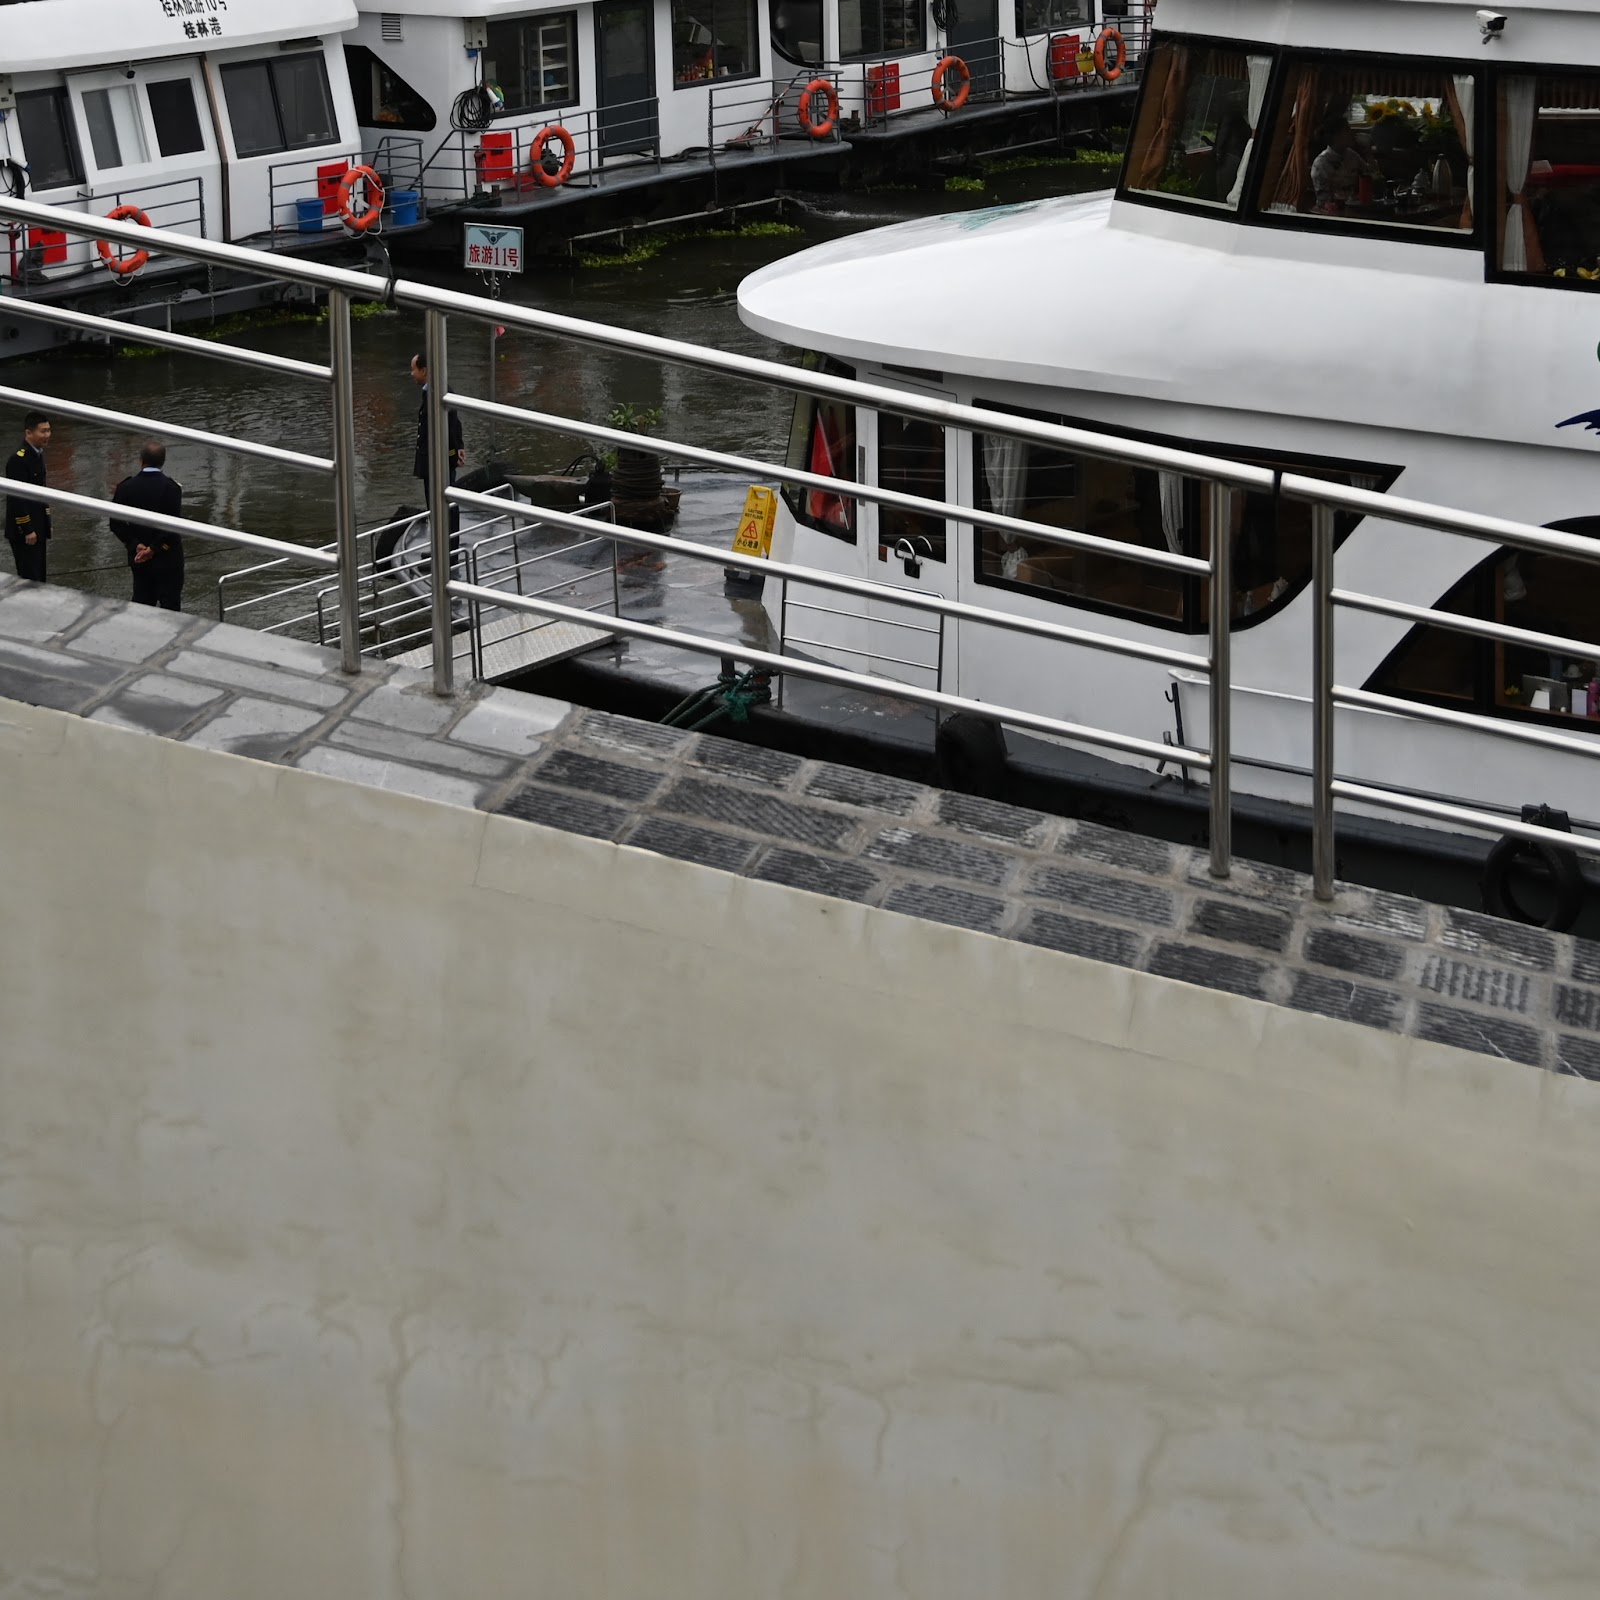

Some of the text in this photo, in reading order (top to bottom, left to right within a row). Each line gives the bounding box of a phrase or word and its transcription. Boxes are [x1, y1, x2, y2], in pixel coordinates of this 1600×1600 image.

[182, 17, 223, 40] 桂林港
[468, 243, 519, 267] 旅游11号
[736, 537, 759, 549] 小心地滑
